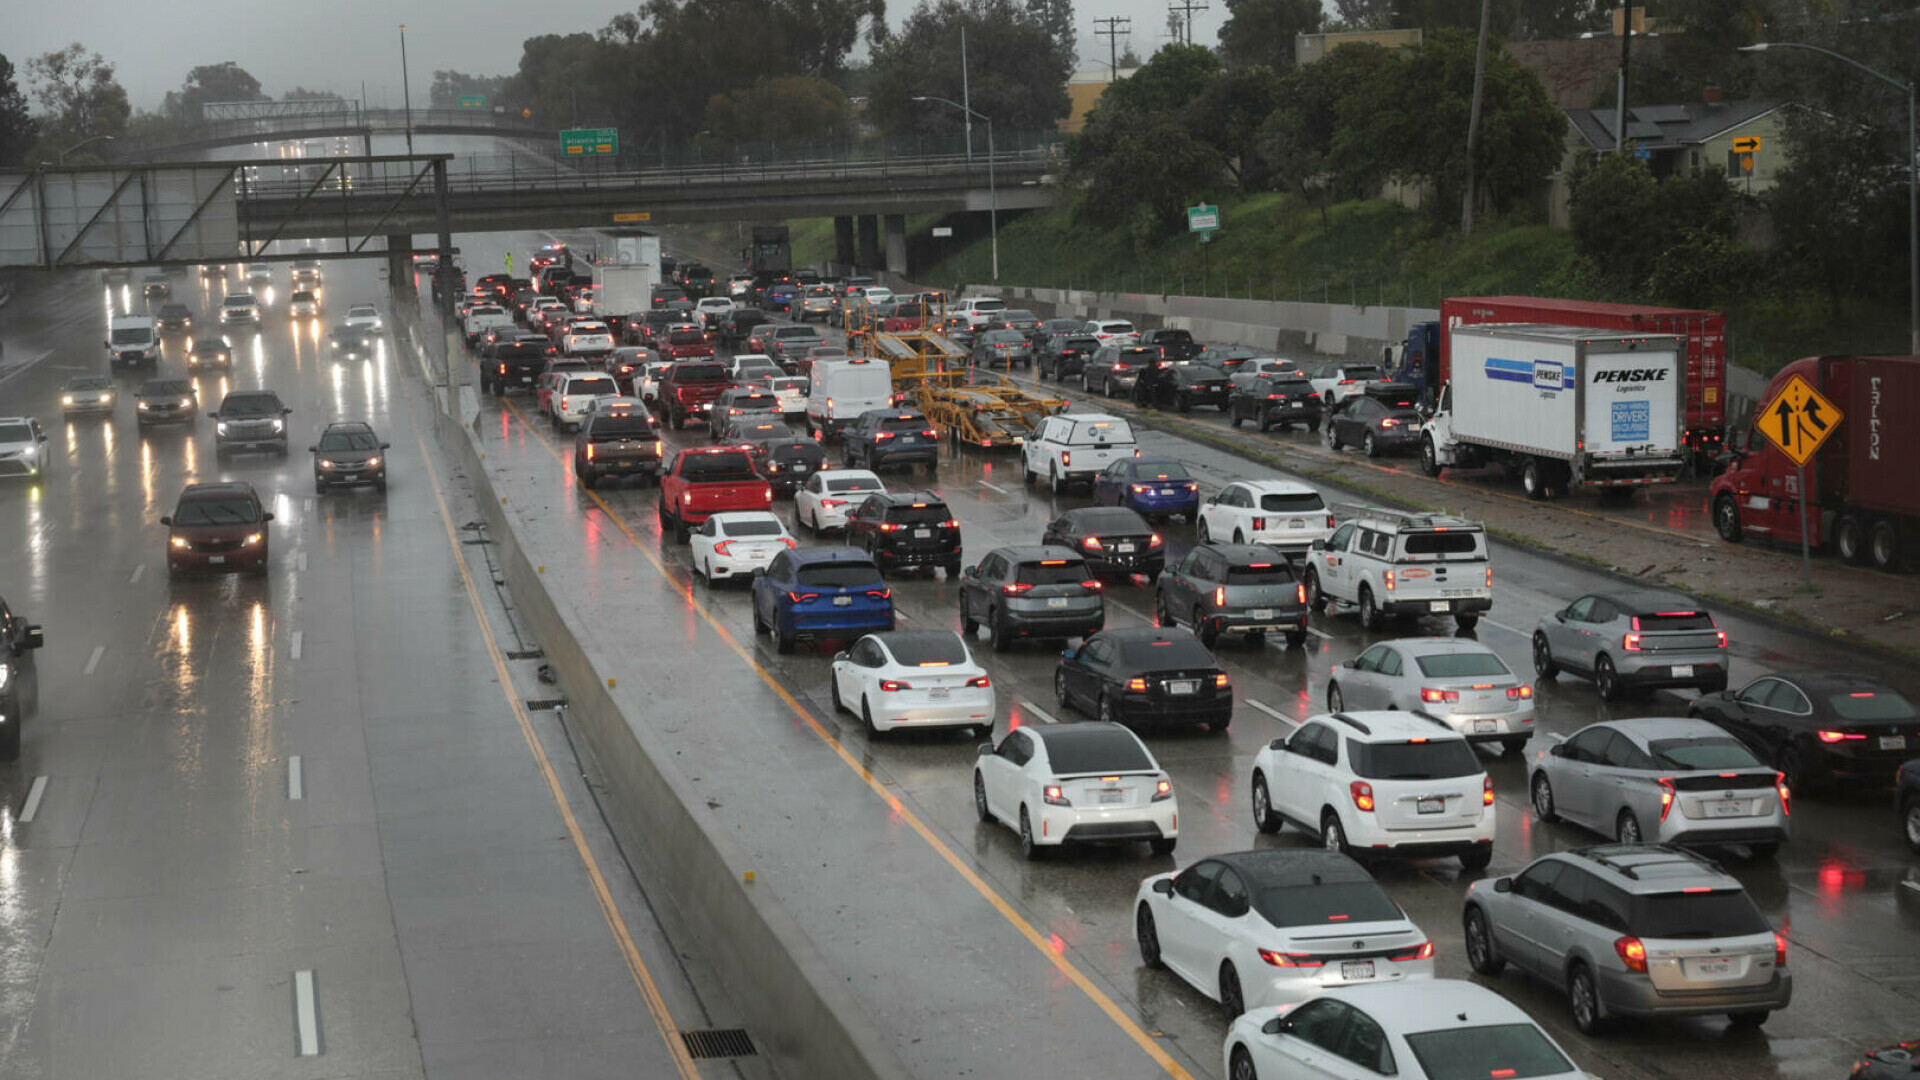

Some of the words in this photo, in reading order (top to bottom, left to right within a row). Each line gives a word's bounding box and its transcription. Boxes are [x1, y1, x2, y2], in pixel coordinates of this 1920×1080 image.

[1536, 369, 1561, 381] PENSKE
[1593, 368, 1669, 384] PENSKE
[1613, 411, 1648, 423] DRIVERS
[1869, 377, 1881, 460] TRITON
